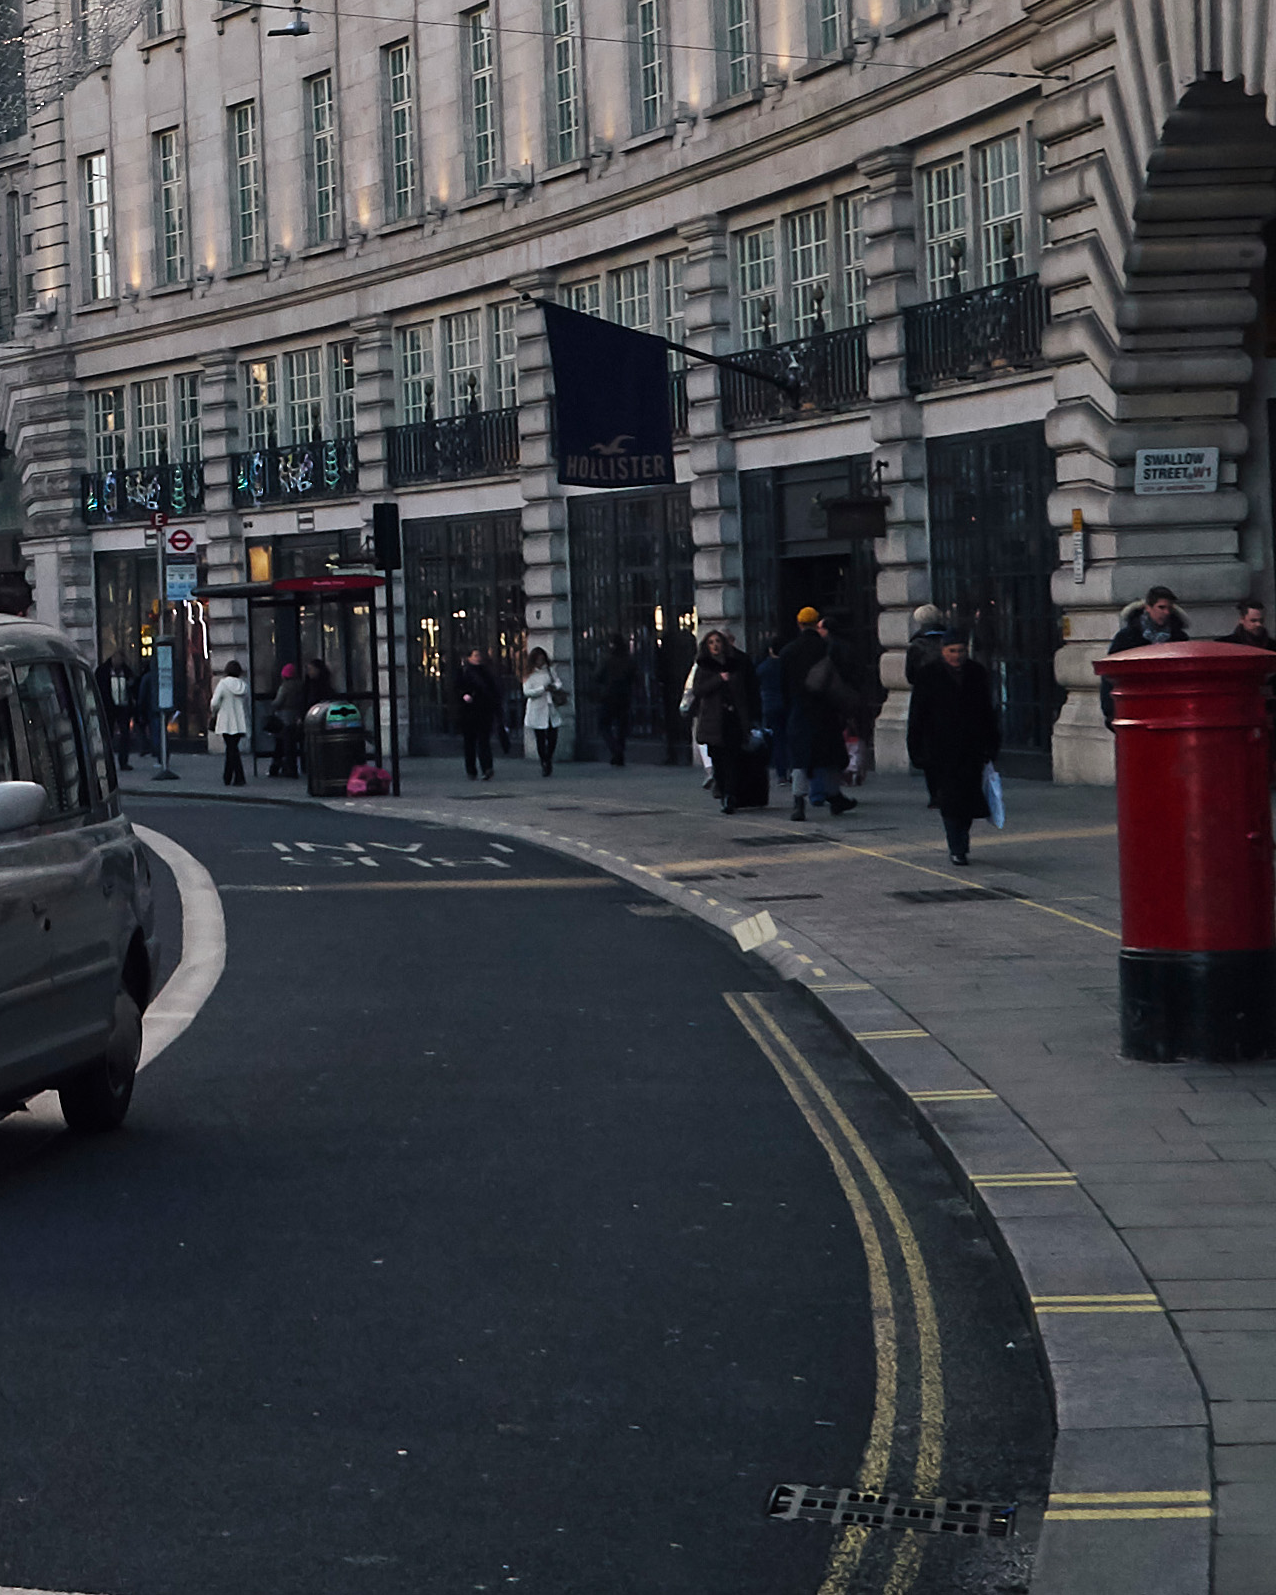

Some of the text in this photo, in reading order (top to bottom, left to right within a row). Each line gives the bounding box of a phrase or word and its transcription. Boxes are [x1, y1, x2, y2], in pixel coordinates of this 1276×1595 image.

[1144, 453, 1205, 466] SWALLOW
[566, 454, 666, 481] HOLLISTER
[1143, 467, 1188, 480] STREET
[155, 512, 164, 526] E
